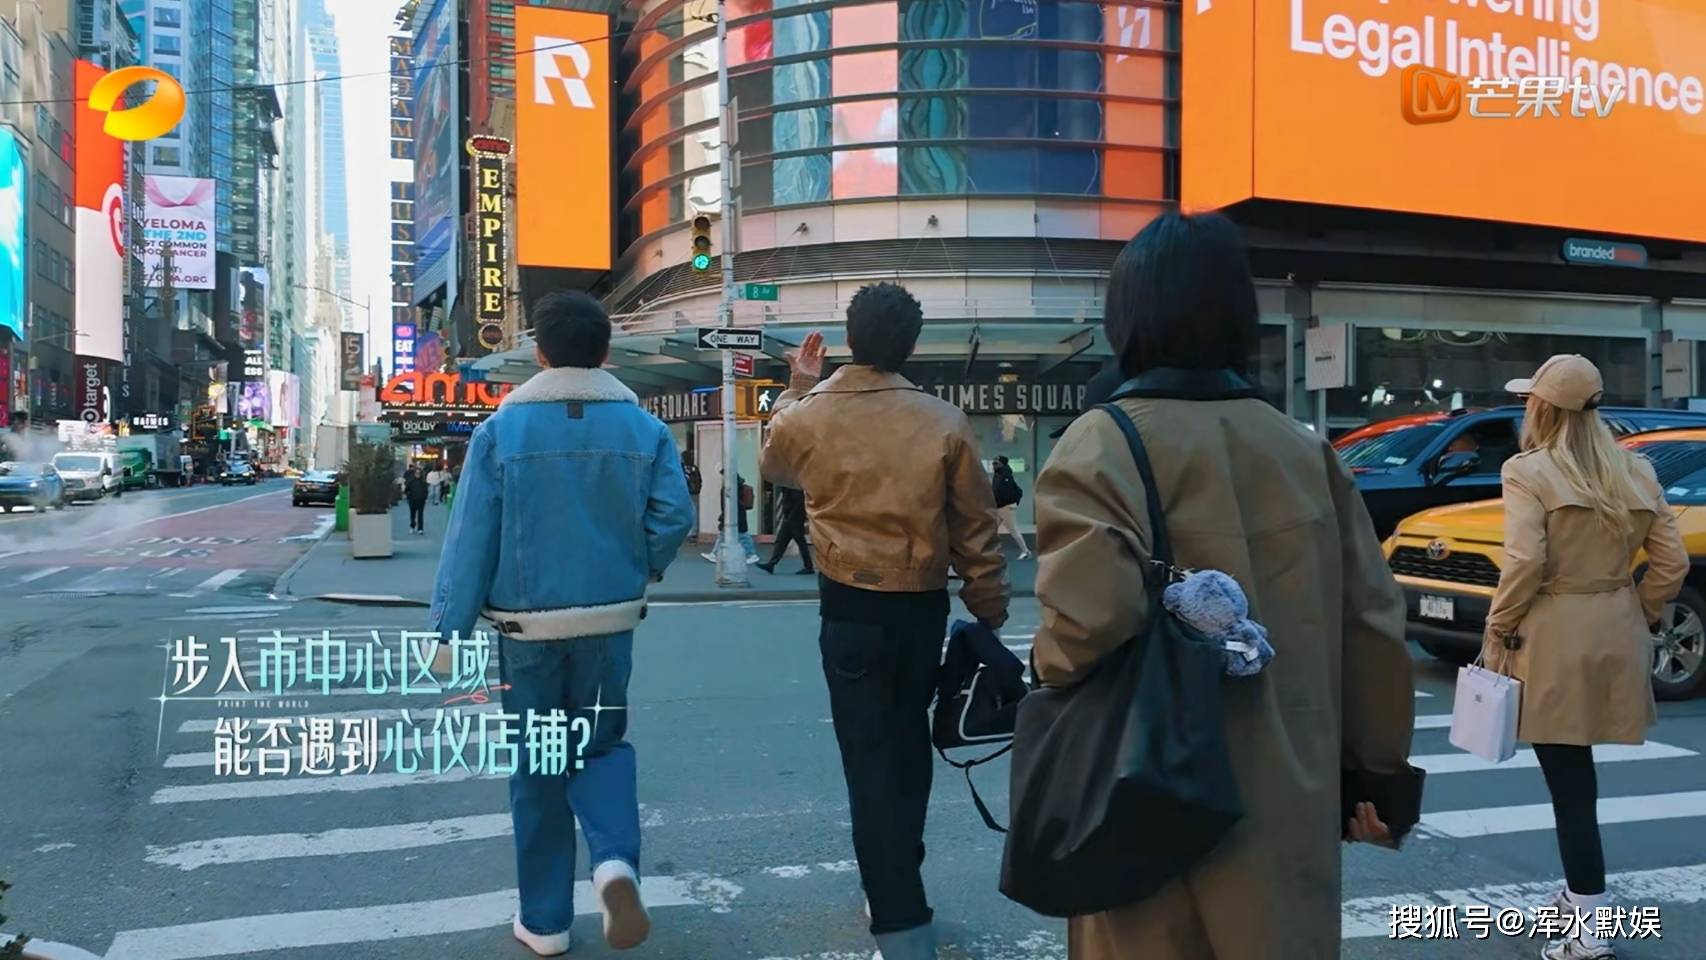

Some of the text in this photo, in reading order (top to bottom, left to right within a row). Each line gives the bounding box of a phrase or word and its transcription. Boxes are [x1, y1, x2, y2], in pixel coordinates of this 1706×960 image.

[1290, 0, 1436, 77] Legal
[1445, 18, 1705, 115] Intelligence
[176, 231, 207, 241] 2ND
[480, 168, 502, 313] EMPIRE
[1569, 242, 1615, 260] branded
[752, 286, 758, 298] 8
[394, 339, 414, 353] EAT
[710, 335, 755, 344] ONE WAY
[83, 363, 101, 407] target
[380, 371, 511, 405] amc
[661, 392, 708, 420] SQUARE
[935, 384, 1005, 410] TIMES
[402, 421, 437, 432] DOLBY
